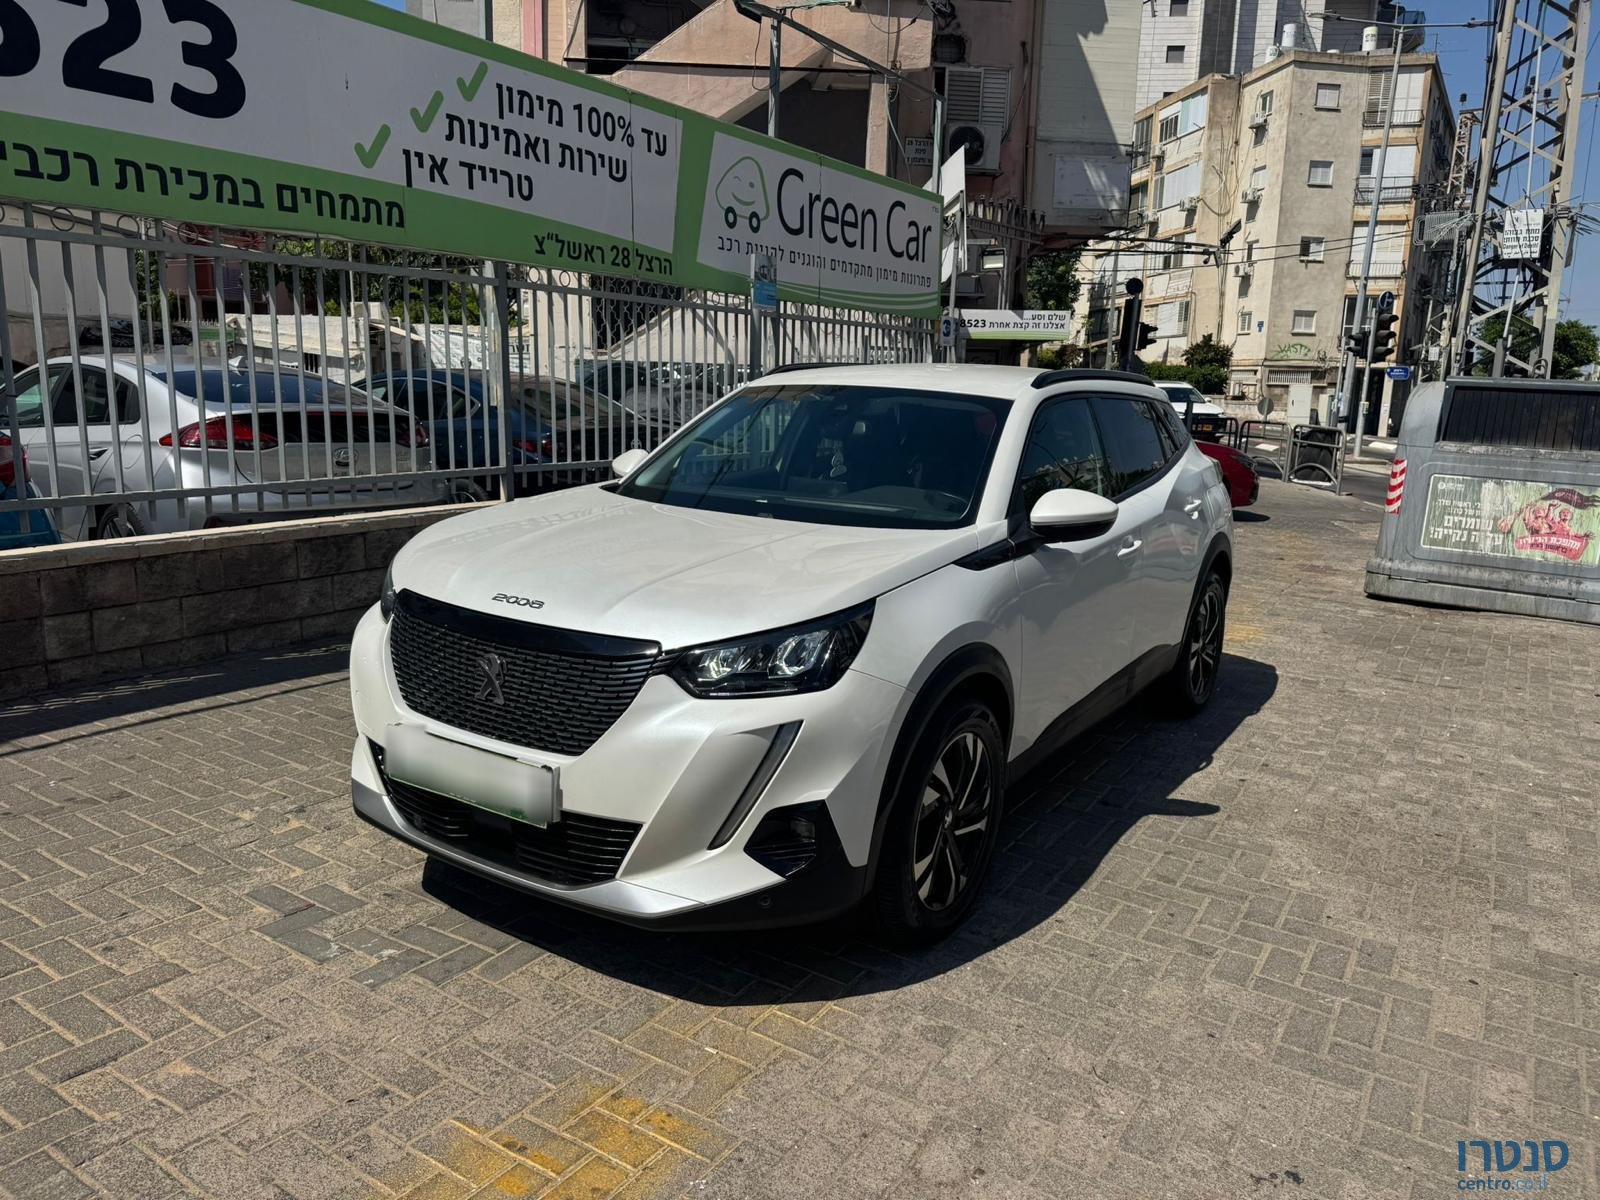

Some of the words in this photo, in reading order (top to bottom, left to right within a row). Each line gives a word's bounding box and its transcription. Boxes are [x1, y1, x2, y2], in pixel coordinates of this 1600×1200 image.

[496, 82, 564, 127] מימון
[573, 103, 635, 147] 100%
[445, 112, 550, 164] ואמינות
[641, 126, 667, 157] עד
[402, 148, 449, 188] אין
[558, 142, 628, 183] שירות
[114, 158, 265, 209] במכירת
[458, 160, 534, 201] טרייד
[275, 183, 406, 229] מתמחים
[776, 168, 878, 253] Green
[886, 200, 932, 263] Car
[717, 236, 741, 253] רכב
[610, 246, 631, 269] 28
[634, 247, 673, 276] הרצל
[789, 249, 826, 270] והוגנים
[830, 257, 873, 279] מתקדמים
[876, 267, 898, 283] מימון
[901, 271, 932, 288] פתרונות
[988, 321, 1011, 329] אחרת
[1012, 321, 1030, 331] קצת
[1031, 321, 1041, 329] זה
[1042, 321, 1065, 329] אצלנו
[1047, 313, 1066, 321] שלם
[491, 593, 545, 610] 2008
